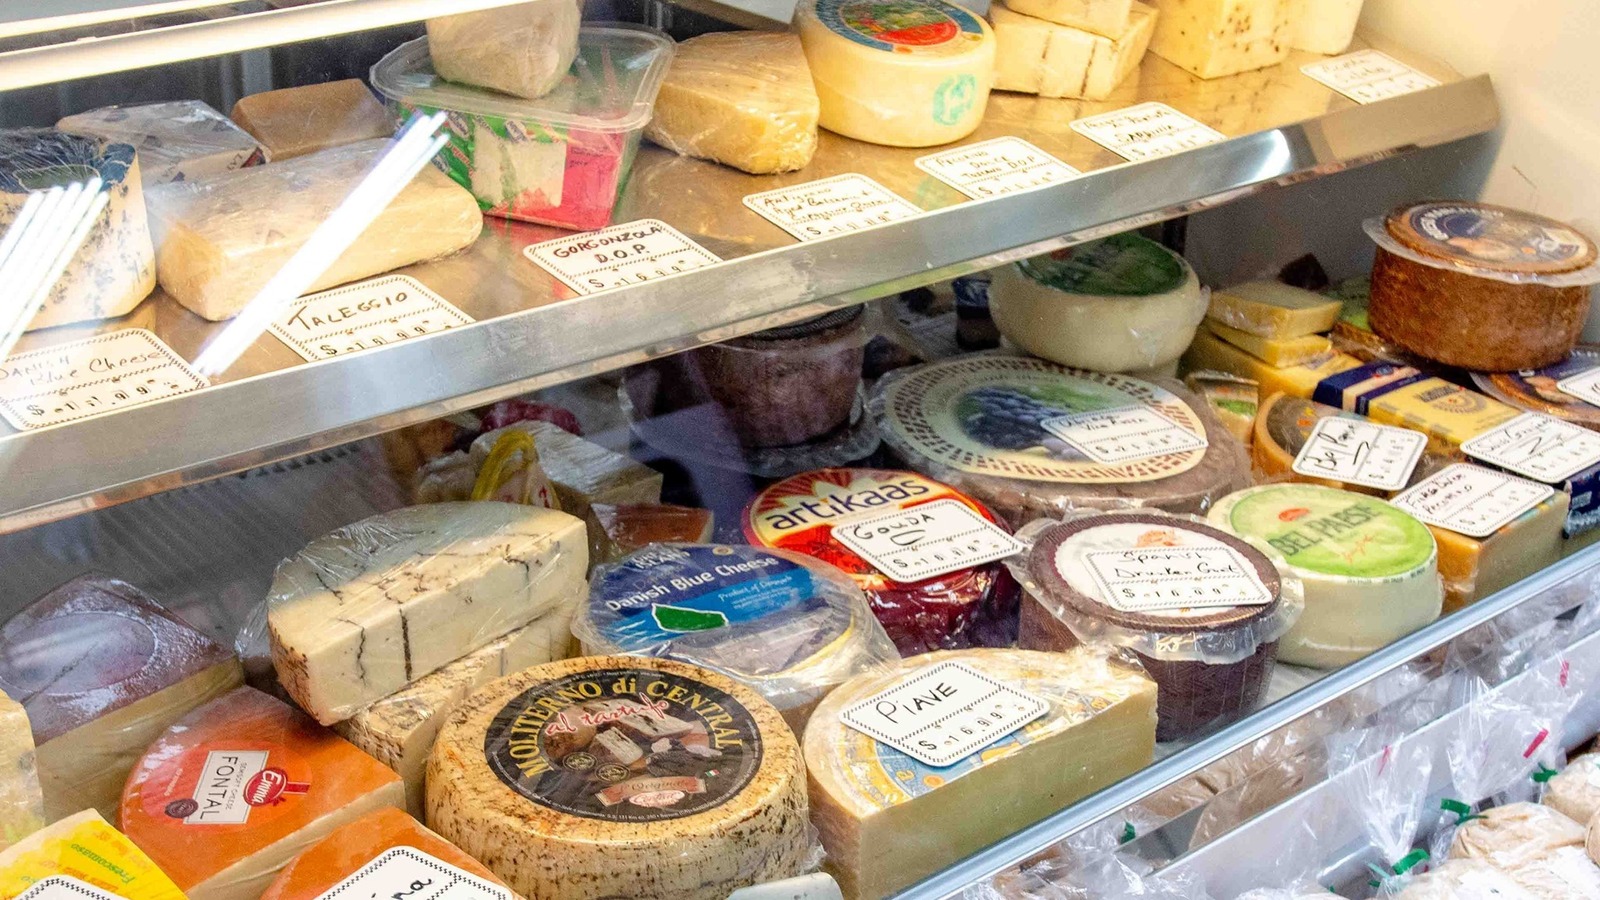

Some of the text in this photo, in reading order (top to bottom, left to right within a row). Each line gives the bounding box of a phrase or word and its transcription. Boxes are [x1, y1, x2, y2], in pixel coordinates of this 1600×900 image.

[553, 226, 662, 259] GORGONZOLA
[287, 292, 408, 331] TALEGGIO
[765, 480, 929, 530] artikaas
[606, 557, 779, 611] Danish Blue Cheese
[545, 692, 670, 737] al tartufo
[875, 682, 958, 724] PIAVE
[509, 676, 743, 778] MOLITERNO di CENTRAL
[200, 756, 239, 820] FONTAL
[252, 769, 282, 805] Emma
